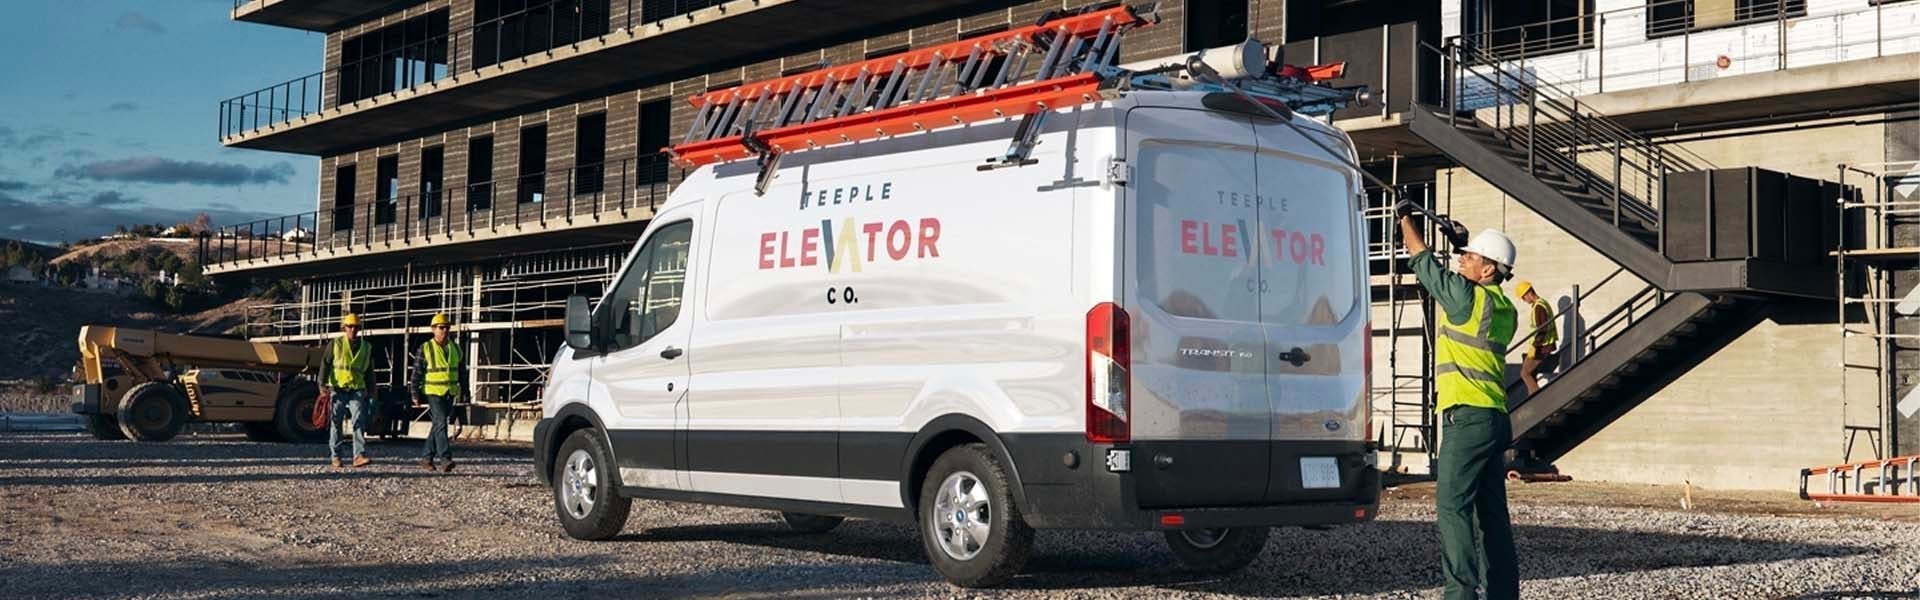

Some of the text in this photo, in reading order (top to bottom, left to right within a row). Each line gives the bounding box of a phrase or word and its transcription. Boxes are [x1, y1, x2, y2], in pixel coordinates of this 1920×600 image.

[802, 182, 892, 209] TEEPLE
[1217, 190, 1289, 212] TEEPLE
[758, 216, 941, 274] ELEVATOR
[1180, 348, 1236, 358] TRANSIT
